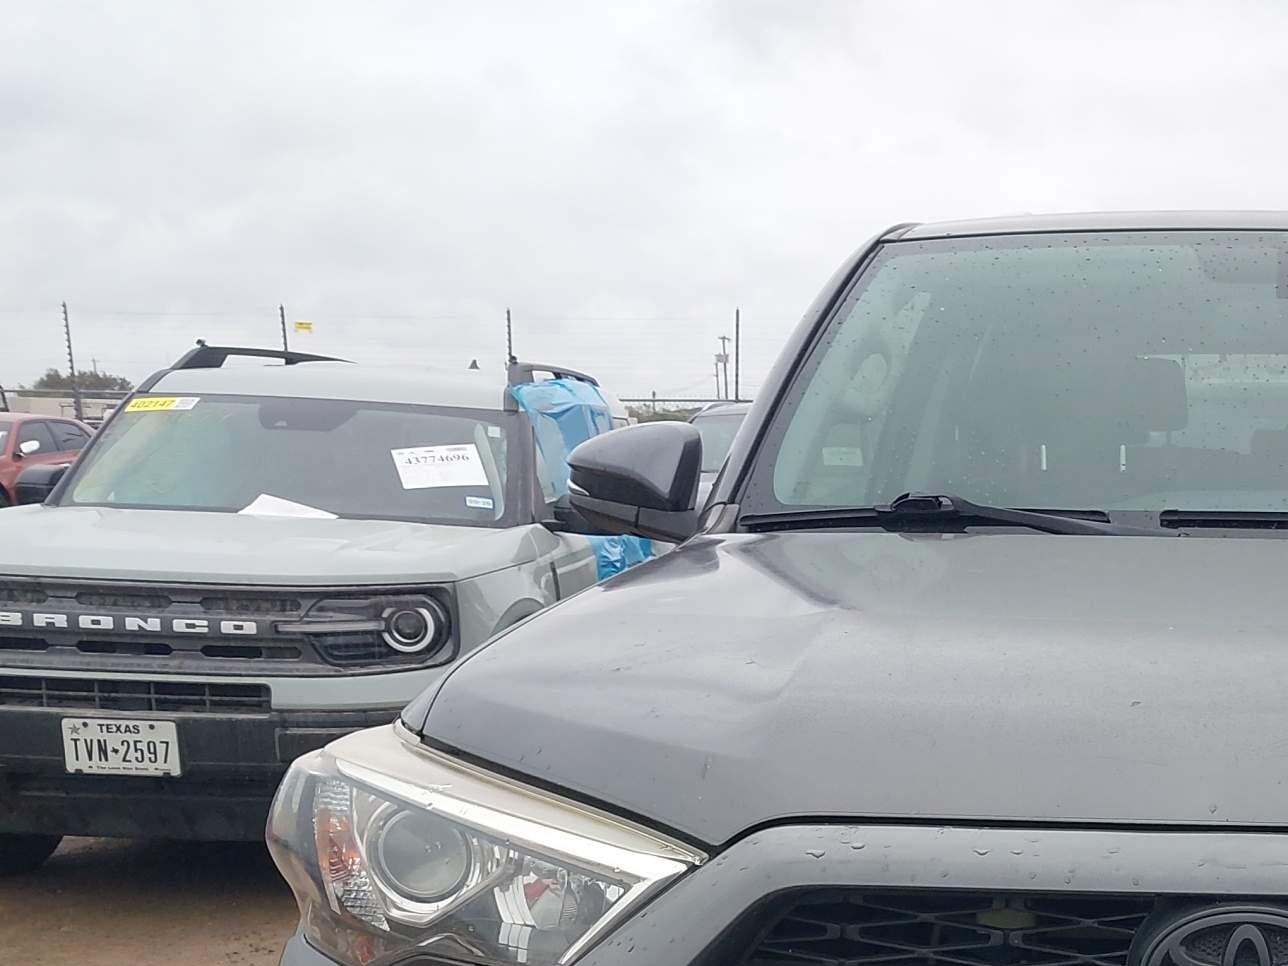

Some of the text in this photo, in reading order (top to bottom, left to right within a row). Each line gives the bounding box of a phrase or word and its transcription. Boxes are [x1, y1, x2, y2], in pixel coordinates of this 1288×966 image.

[404, 453, 470, 465] 43774696
[0, 611, 257, 635] BRONCO
[97, 723, 141, 734] TEXAS
[70, 737, 169, 764] TVN 2597
